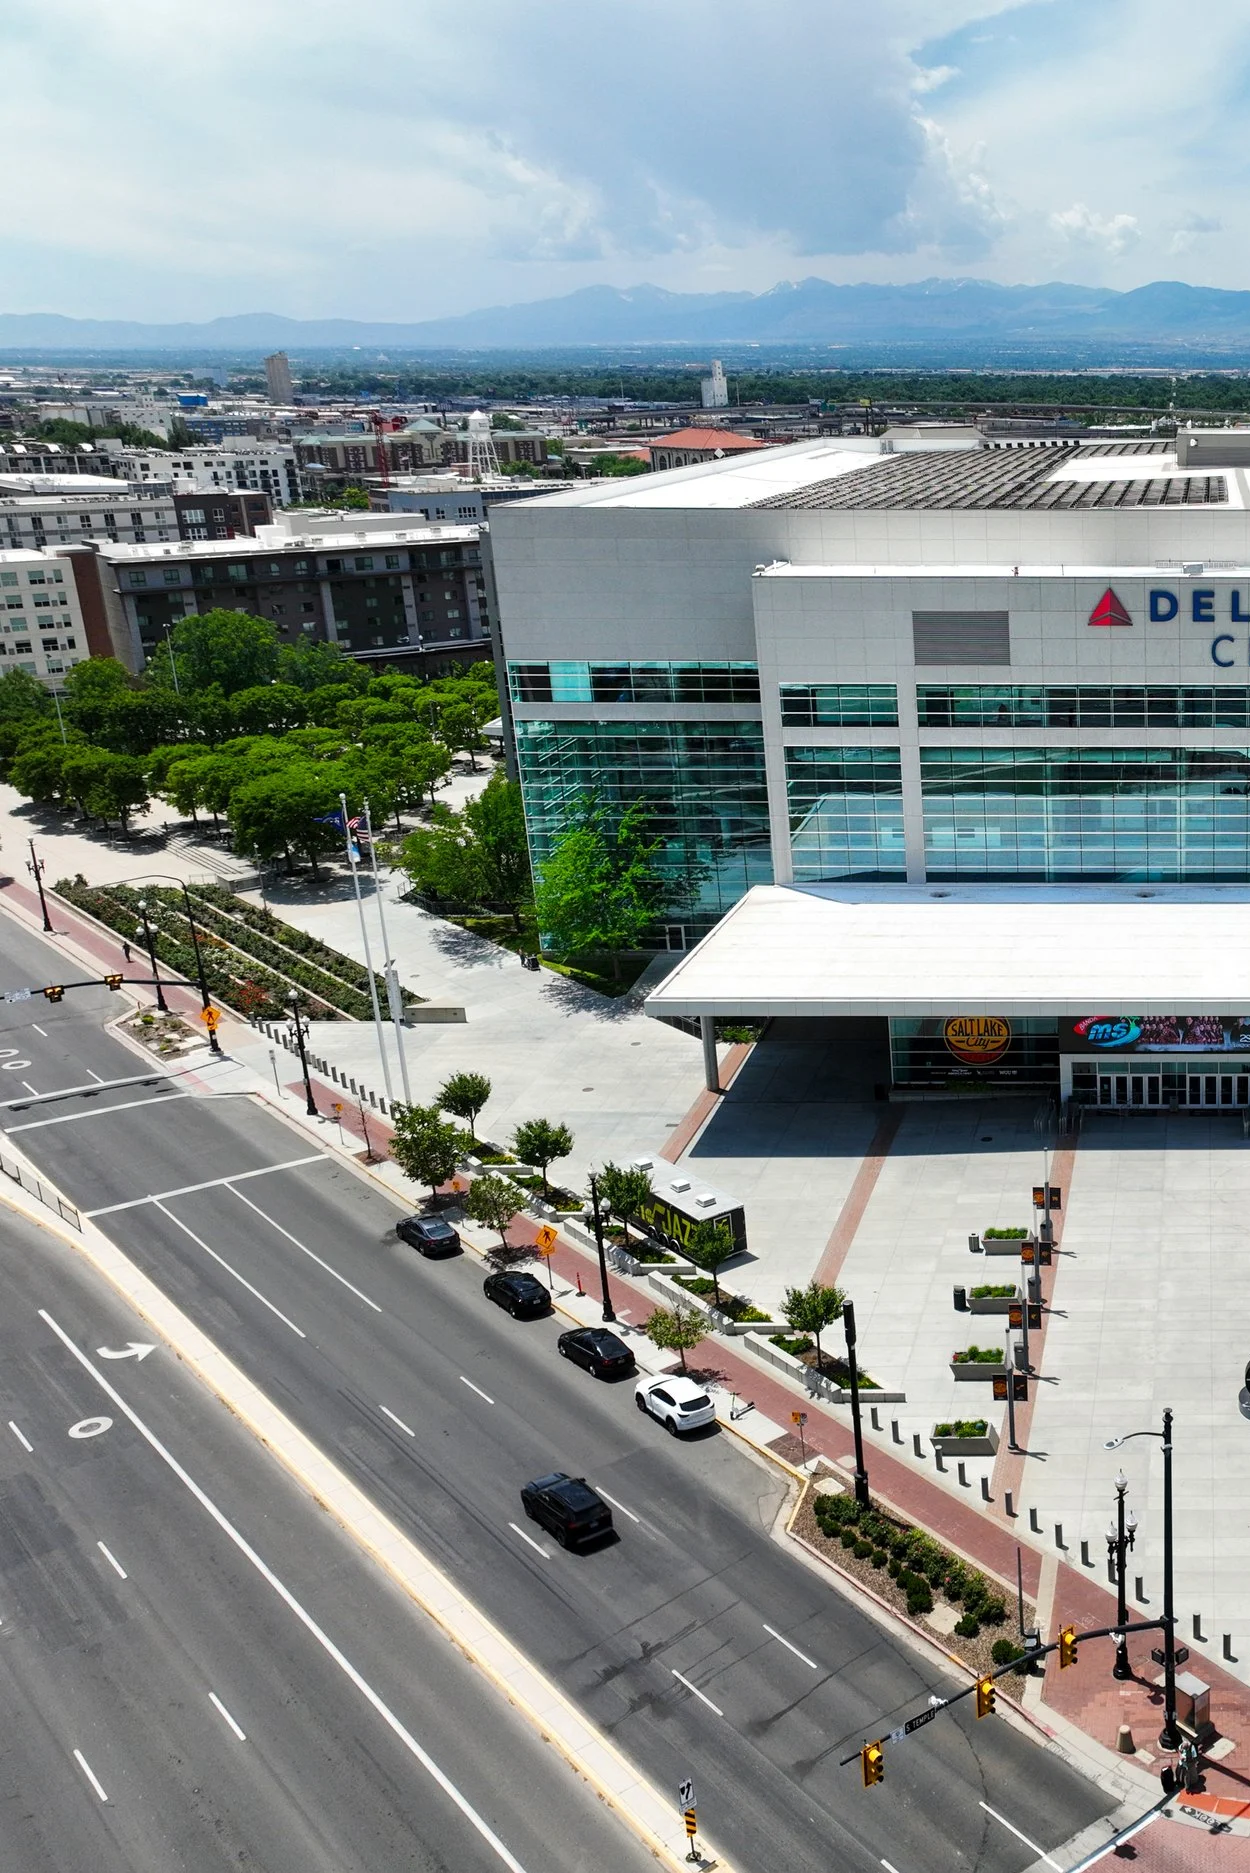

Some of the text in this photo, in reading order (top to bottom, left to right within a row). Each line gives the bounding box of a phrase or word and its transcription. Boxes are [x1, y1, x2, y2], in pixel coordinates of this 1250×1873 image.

[951, 1018, 1004, 1036] SALT LAKE
[965, 1036, 991, 1049] City
[662, 1208, 698, 1248] JAZ
[912, 1710, 935, 1729] TEMPLE
